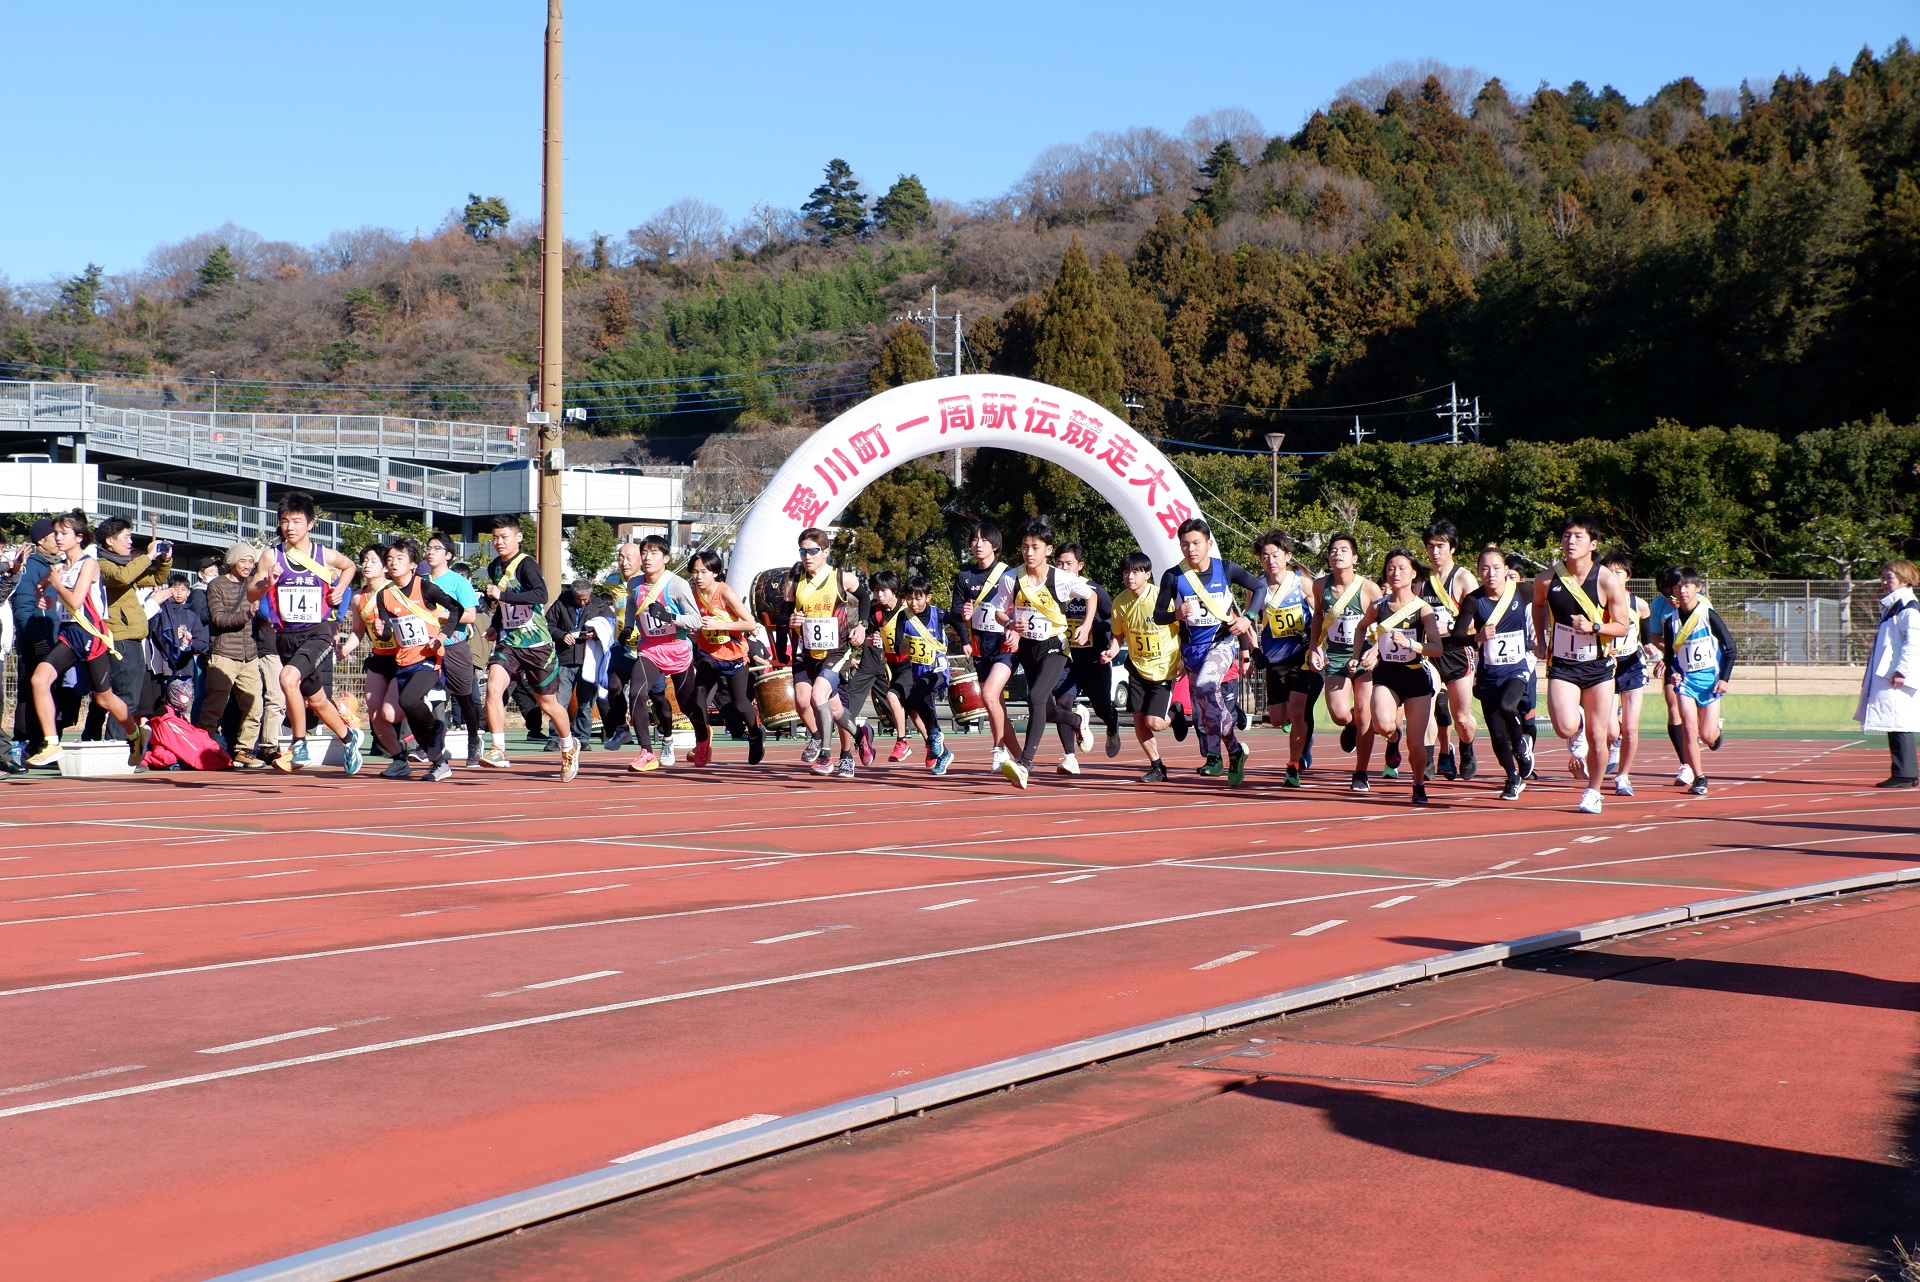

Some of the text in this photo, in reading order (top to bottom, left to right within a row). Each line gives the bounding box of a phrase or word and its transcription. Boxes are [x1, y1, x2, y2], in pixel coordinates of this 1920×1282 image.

[781, 392, 1196, 540] 愛川町一周駅伝競走大会
[285, 576, 315, 586] 二井坂
[289, 594, 318, 613] 14-1
[285, 613, 314, 621] 二井坂区
[980, 608, 995, 624] 7-
[1275, 613, 1304, 630] 50-1
[398, 622, 425, 640] 13-1
[813, 624, 835, 641] 8-1
[908, 641, 934, 660] 53-1
[1135, 636, 1161, 652] 51-1
[1497, 639, 1521, 657] 2-1
[1569, 634, 1593, 654] 1-1
[1685, 646, 1713, 664] 16-1
